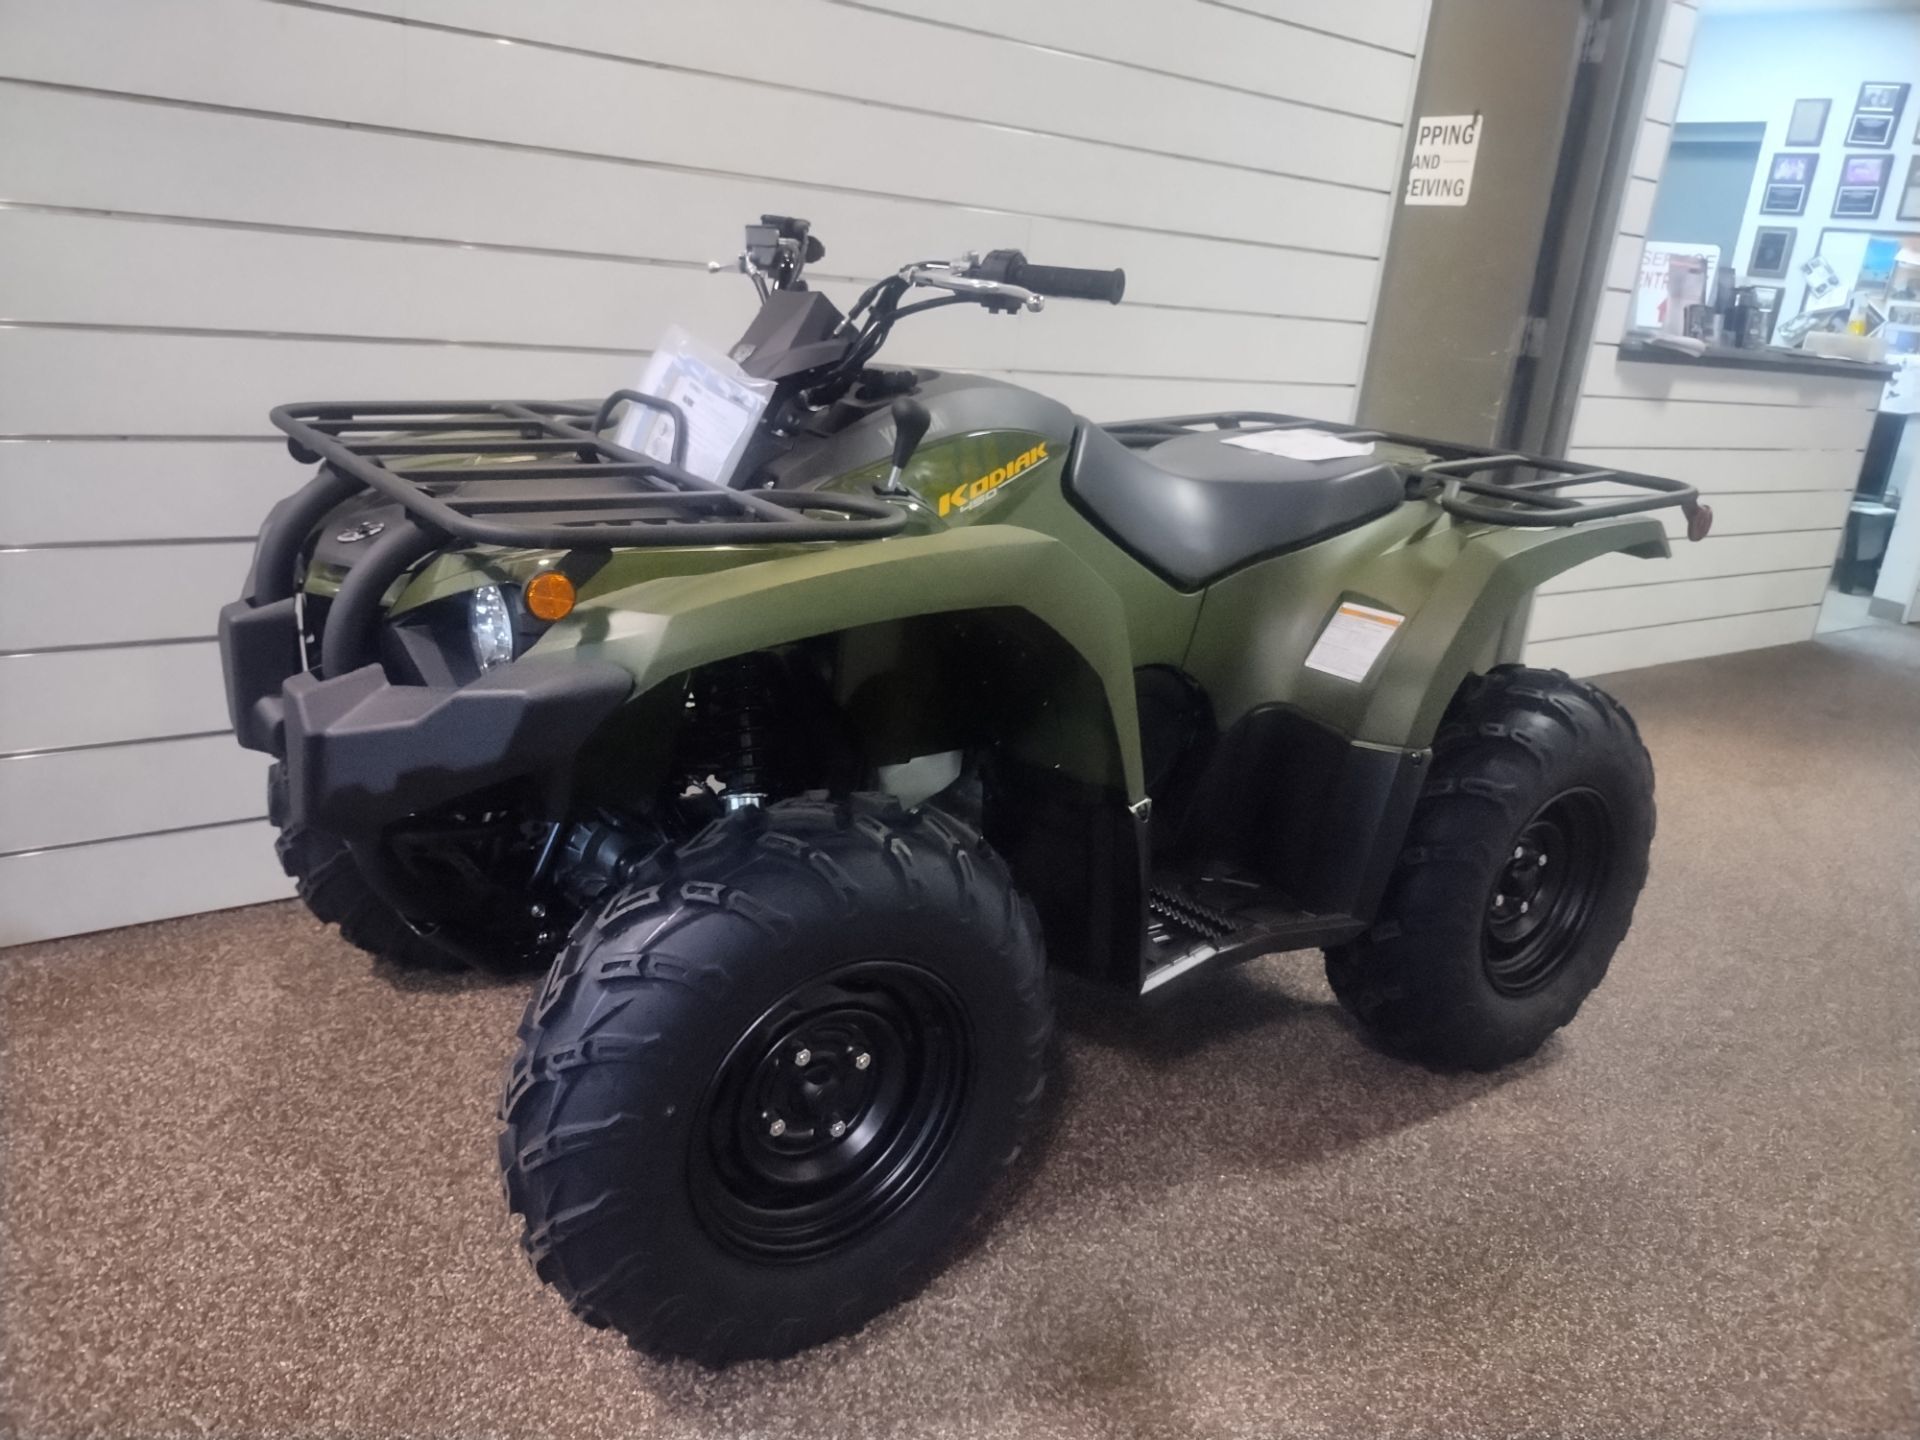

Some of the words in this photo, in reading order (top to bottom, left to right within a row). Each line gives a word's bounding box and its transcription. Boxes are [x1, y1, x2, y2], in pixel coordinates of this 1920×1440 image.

[1419, 124, 1475, 145] PPING
[1411, 154, 1440, 169] AND
[1410, 178, 1465, 197] EIVING
[939, 441, 1048, 517] KODIAK
